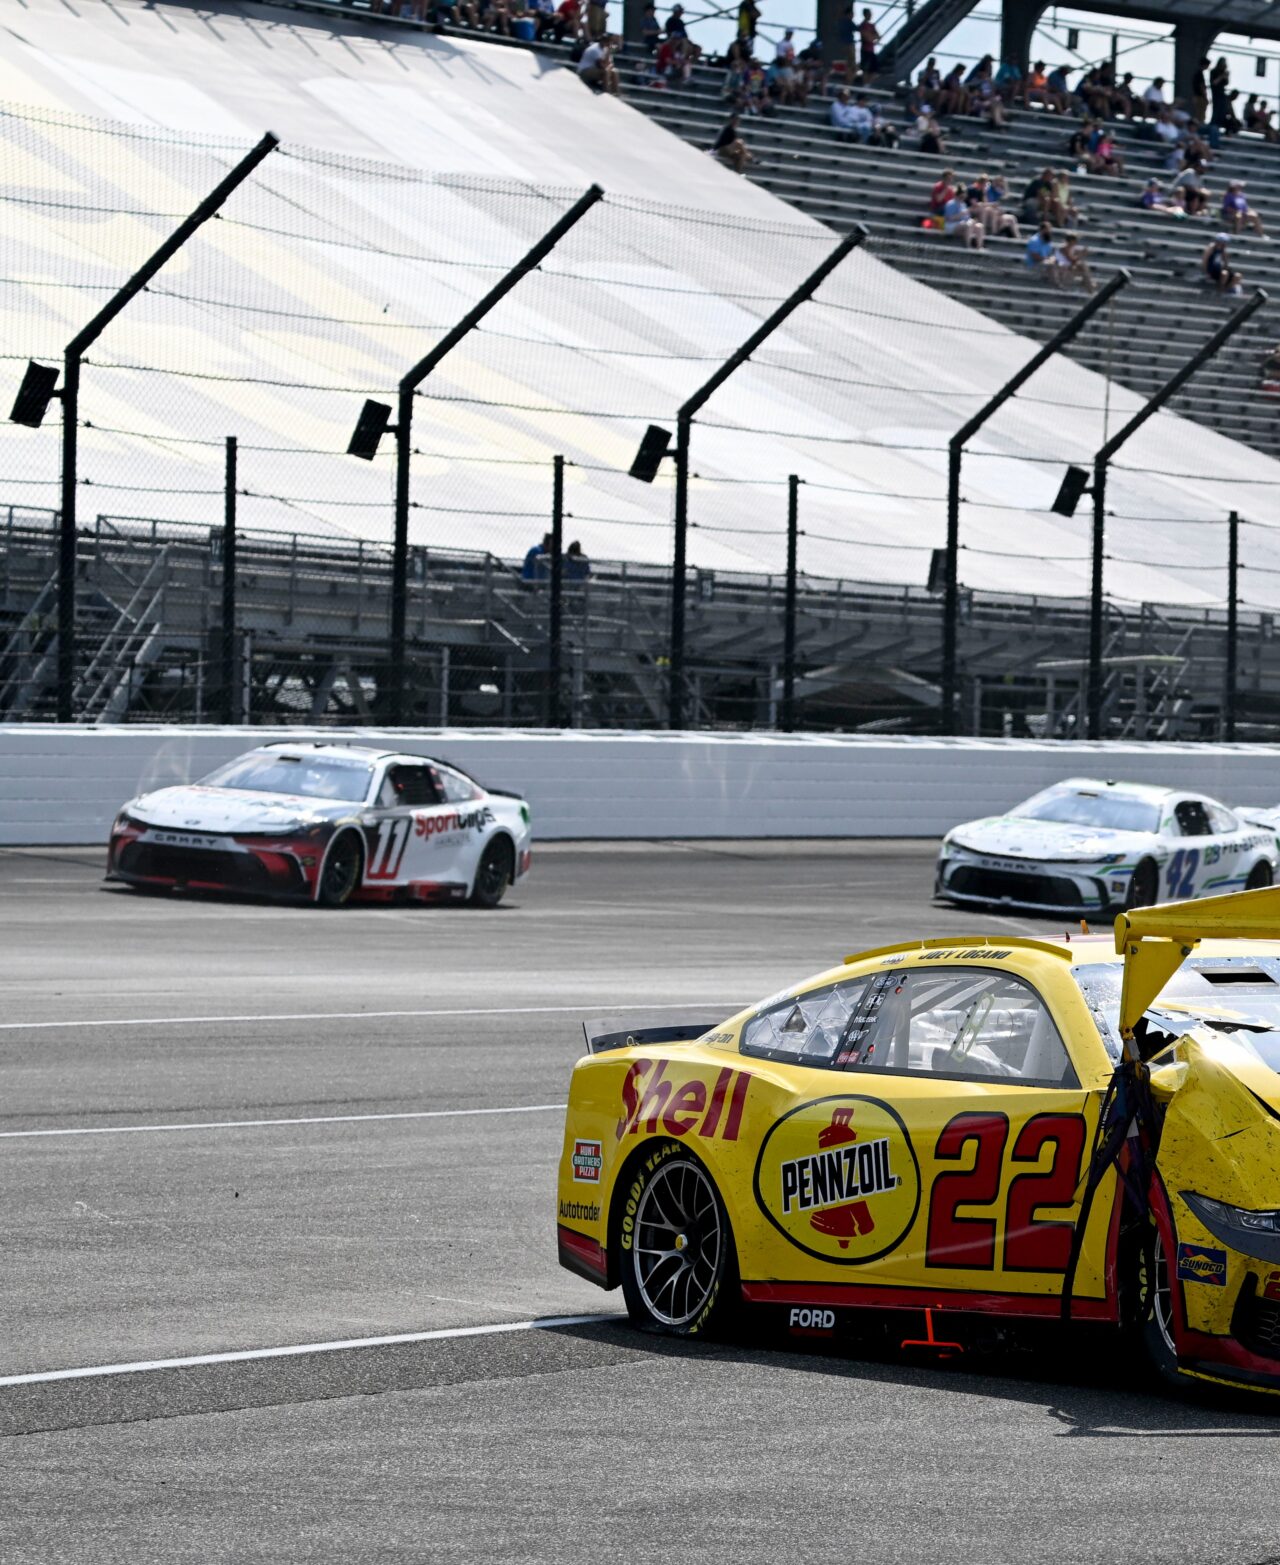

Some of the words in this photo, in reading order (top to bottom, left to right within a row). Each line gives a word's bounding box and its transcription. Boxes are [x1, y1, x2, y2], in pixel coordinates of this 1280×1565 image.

[366, 815, 413, 879] 11
[1166, 848, 1201, 898] 42
[918, 950, 953, 960] JOEY
[955, 949, 1012, 960] LOGANO
[616, 1057, 752, 1142] Shell
[580, 1146, 595, 1156] HUNT
[574, 1156, 601, 1167] BROTHERS
[579, 1167, 595, 1177] PIZZA
[780, 1136, 897, 1215] PENNZOIL
[925, 1110, 1087, 1274] 22
[559, 1200, 600, 1221] Autotrader
[1181, 1257, 1224, 1273] SUNOCO
[789, 1308, 836, 1328] FORD
